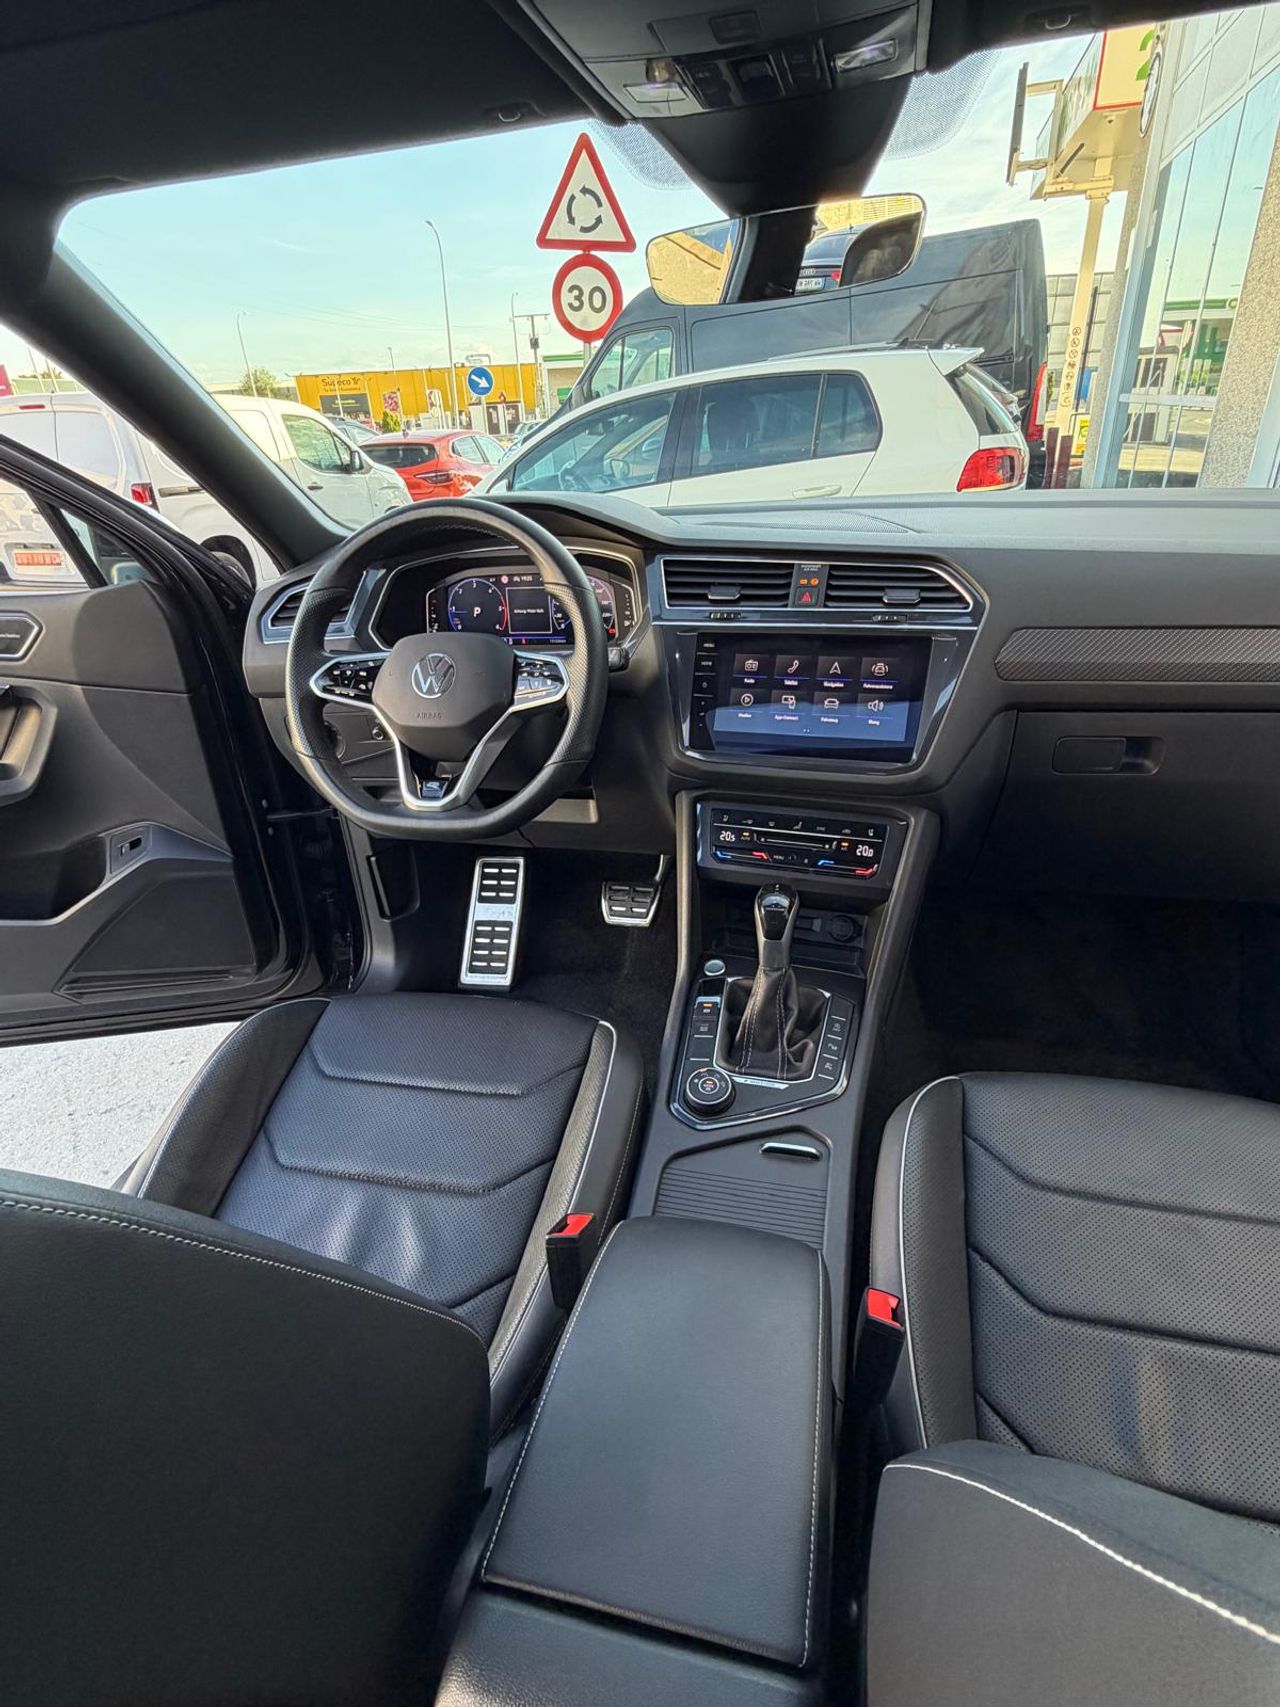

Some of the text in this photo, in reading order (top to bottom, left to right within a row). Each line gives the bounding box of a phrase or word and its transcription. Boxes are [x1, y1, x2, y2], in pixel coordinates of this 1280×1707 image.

[567, 284, 607, 314] 30
[473, 606, 481, 617] P
[416, 711, 442, 719] AIRBAG
